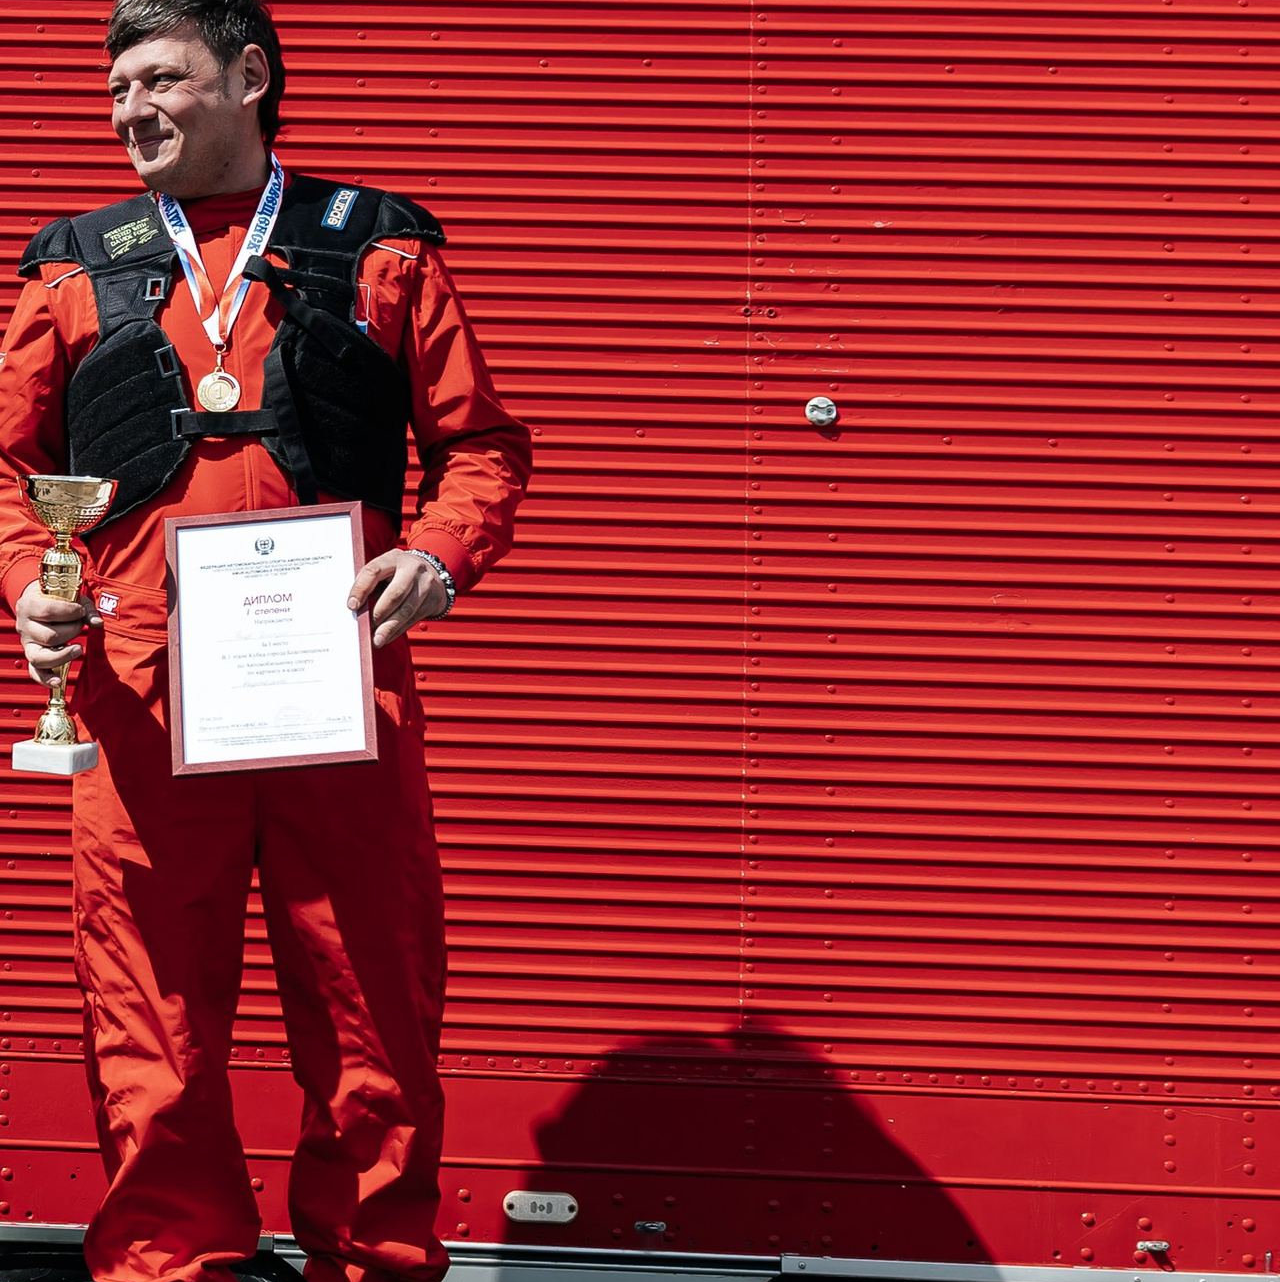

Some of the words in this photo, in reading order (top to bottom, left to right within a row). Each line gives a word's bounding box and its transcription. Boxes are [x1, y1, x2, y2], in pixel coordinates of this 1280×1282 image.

[327, 190, 353, 226] sparco
[110, 229, 132, 240] TESTED
[100, 596, 118, 612] OMP
[242, 592, 292, 606] ДИПЛОМ
[254, 606, 290, 615] степени
